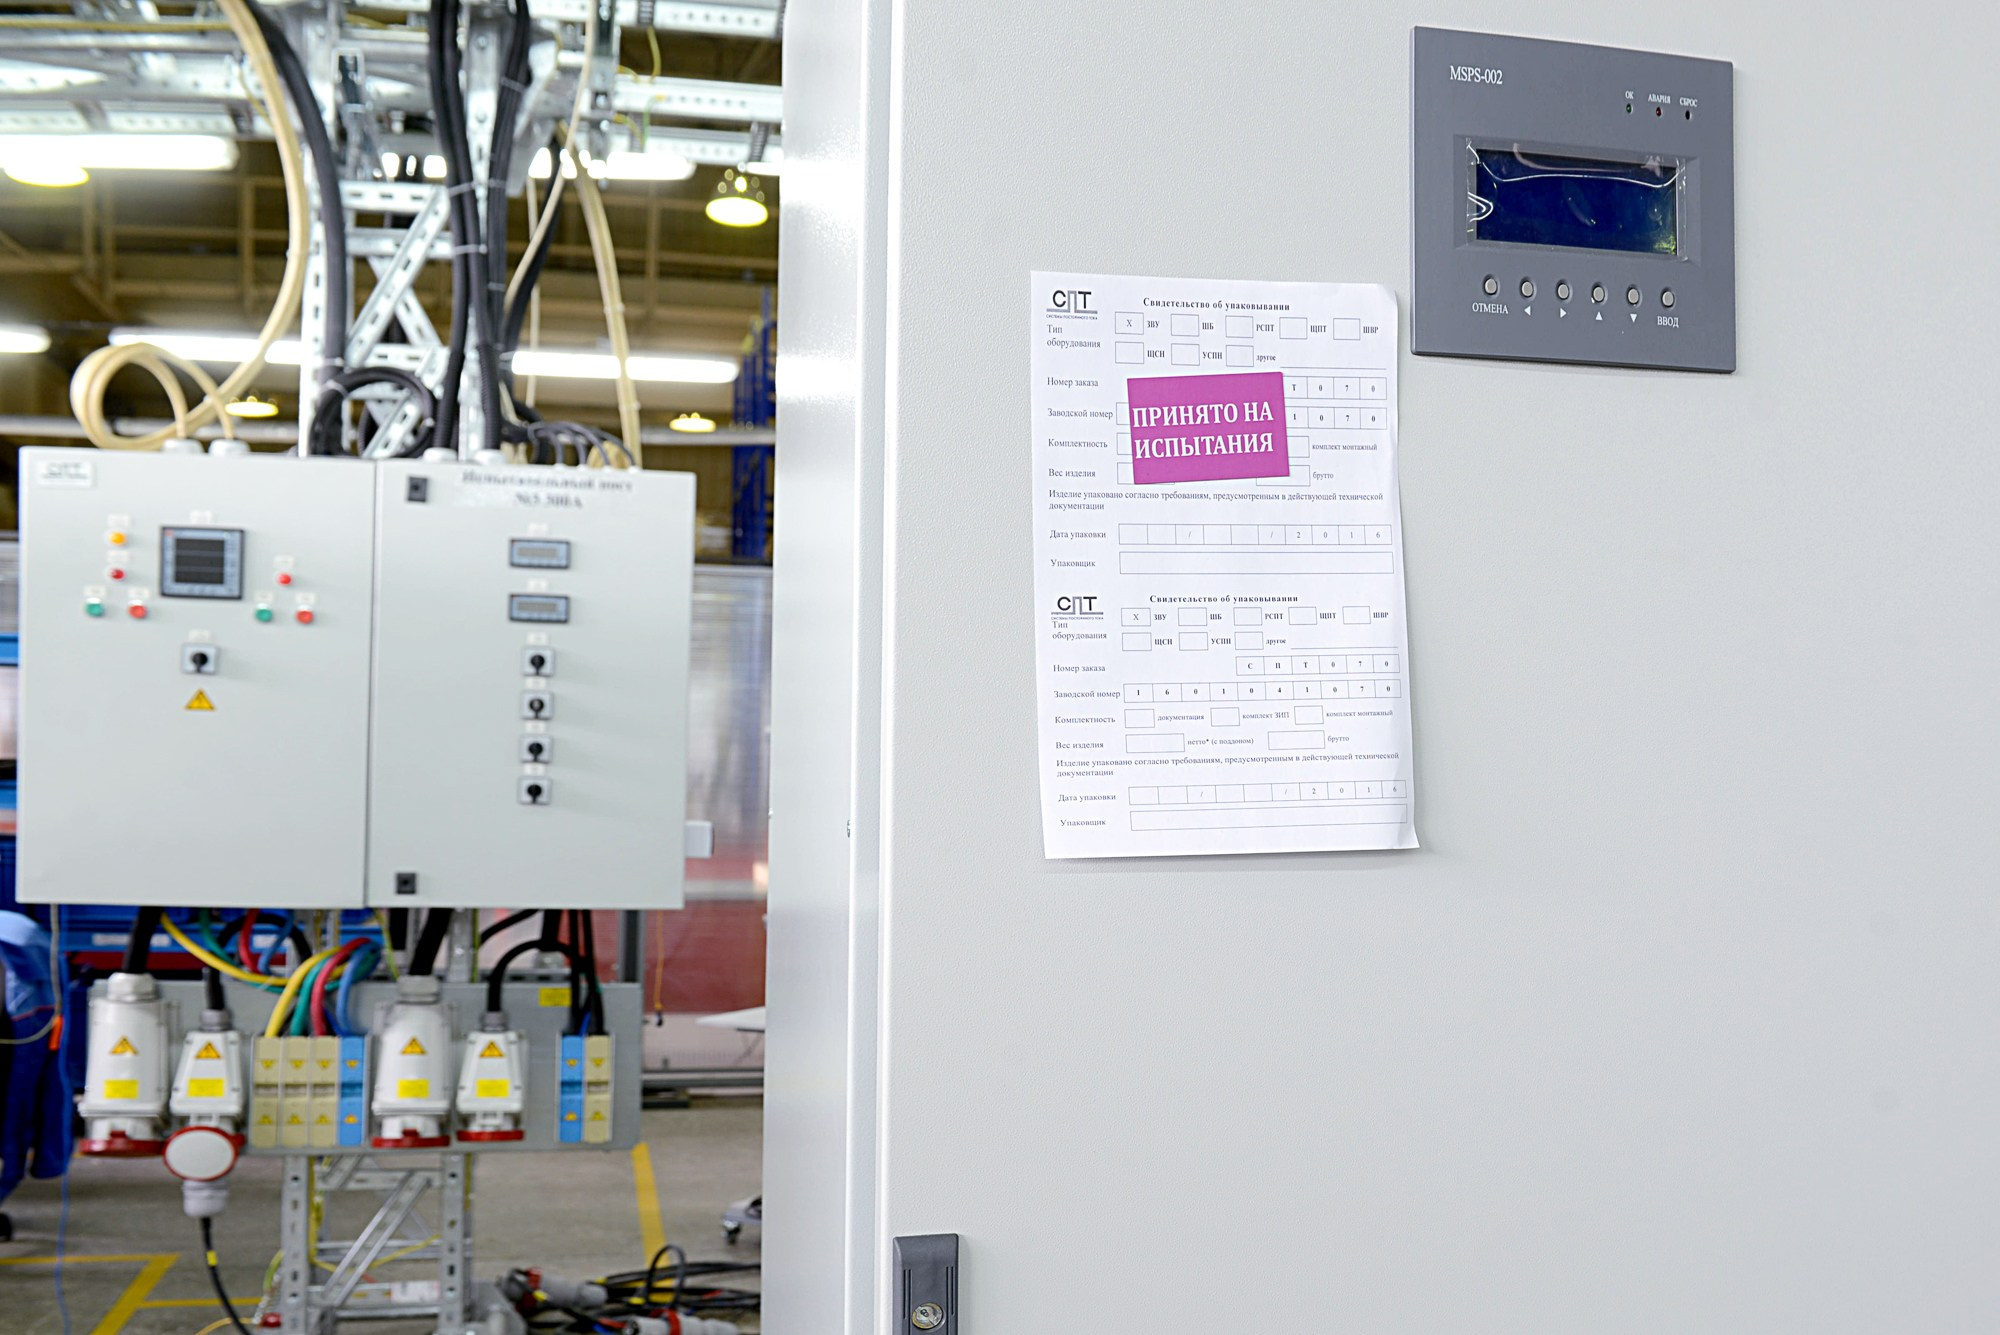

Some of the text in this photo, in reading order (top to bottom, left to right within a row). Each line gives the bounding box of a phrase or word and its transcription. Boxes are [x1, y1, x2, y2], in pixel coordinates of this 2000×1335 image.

[1450, 65, 1503, 84] MSPS-002
[1648, 93, 1671, 104] АВАРИЯ
[1679, 97, 1698, 108] СБРОС
[1052, 290, 1092, 310] СПТ
[1143, 298, 1290, 311] Свидетельство об упаковывании
[1472, 302, 1679, 328] ОТМЕНА ВВОД
[1047, 324, 1063, 334] Тип
[1202, 322, 1214, 330] ШБ
[1256, 324, 1275, 332] РСПТ
[1310, 325, 1327, 334] ЩПТ
[1047, 338, 1100, 348] оборудования
[1147, 350, 1165, 359] ЩСН
[1047, 377, 1073, 388] Номер
[1047, 408, 1088, 418] Заводской
[1090, 410, 1114, 420] номер
[1132, 402, 1274, 428] ПРИНЯТО НА
[1048, 439, 1108, 448] Комплектность
[1134, 433, 1274, 459] ИСПЫТАНИЯ
[1049, 469, 1063, 477] Вес
[1313, 472, 1334, 480] брутто
[1049, 490, 1082, 498] Изделие
[1161, 491, 1211, 500] требованиям,
[1213, 493, 1280, 502] предусмотренным
[1288, 493, 1337, 502] действующей
[1049, 502, 1104, 511] документации
[1050, 530, 1068, 539] Дата
[1070, 532, 1106, 540] упаковки
[1050, 559, 1096, 568] Упаковщик
[1057, 596, 1097, 611] СПТ
[1233, 596, 1298, 604] упаковывании
[1052, 632, 1107, 640] оборудования
[1053, 664, 1080, 673] Номер
[1054, 690, 1095, 699] Заводской
[1171, 757, 1223, 766] требованиям,
[1302, 754, 1353, 762] действующей
